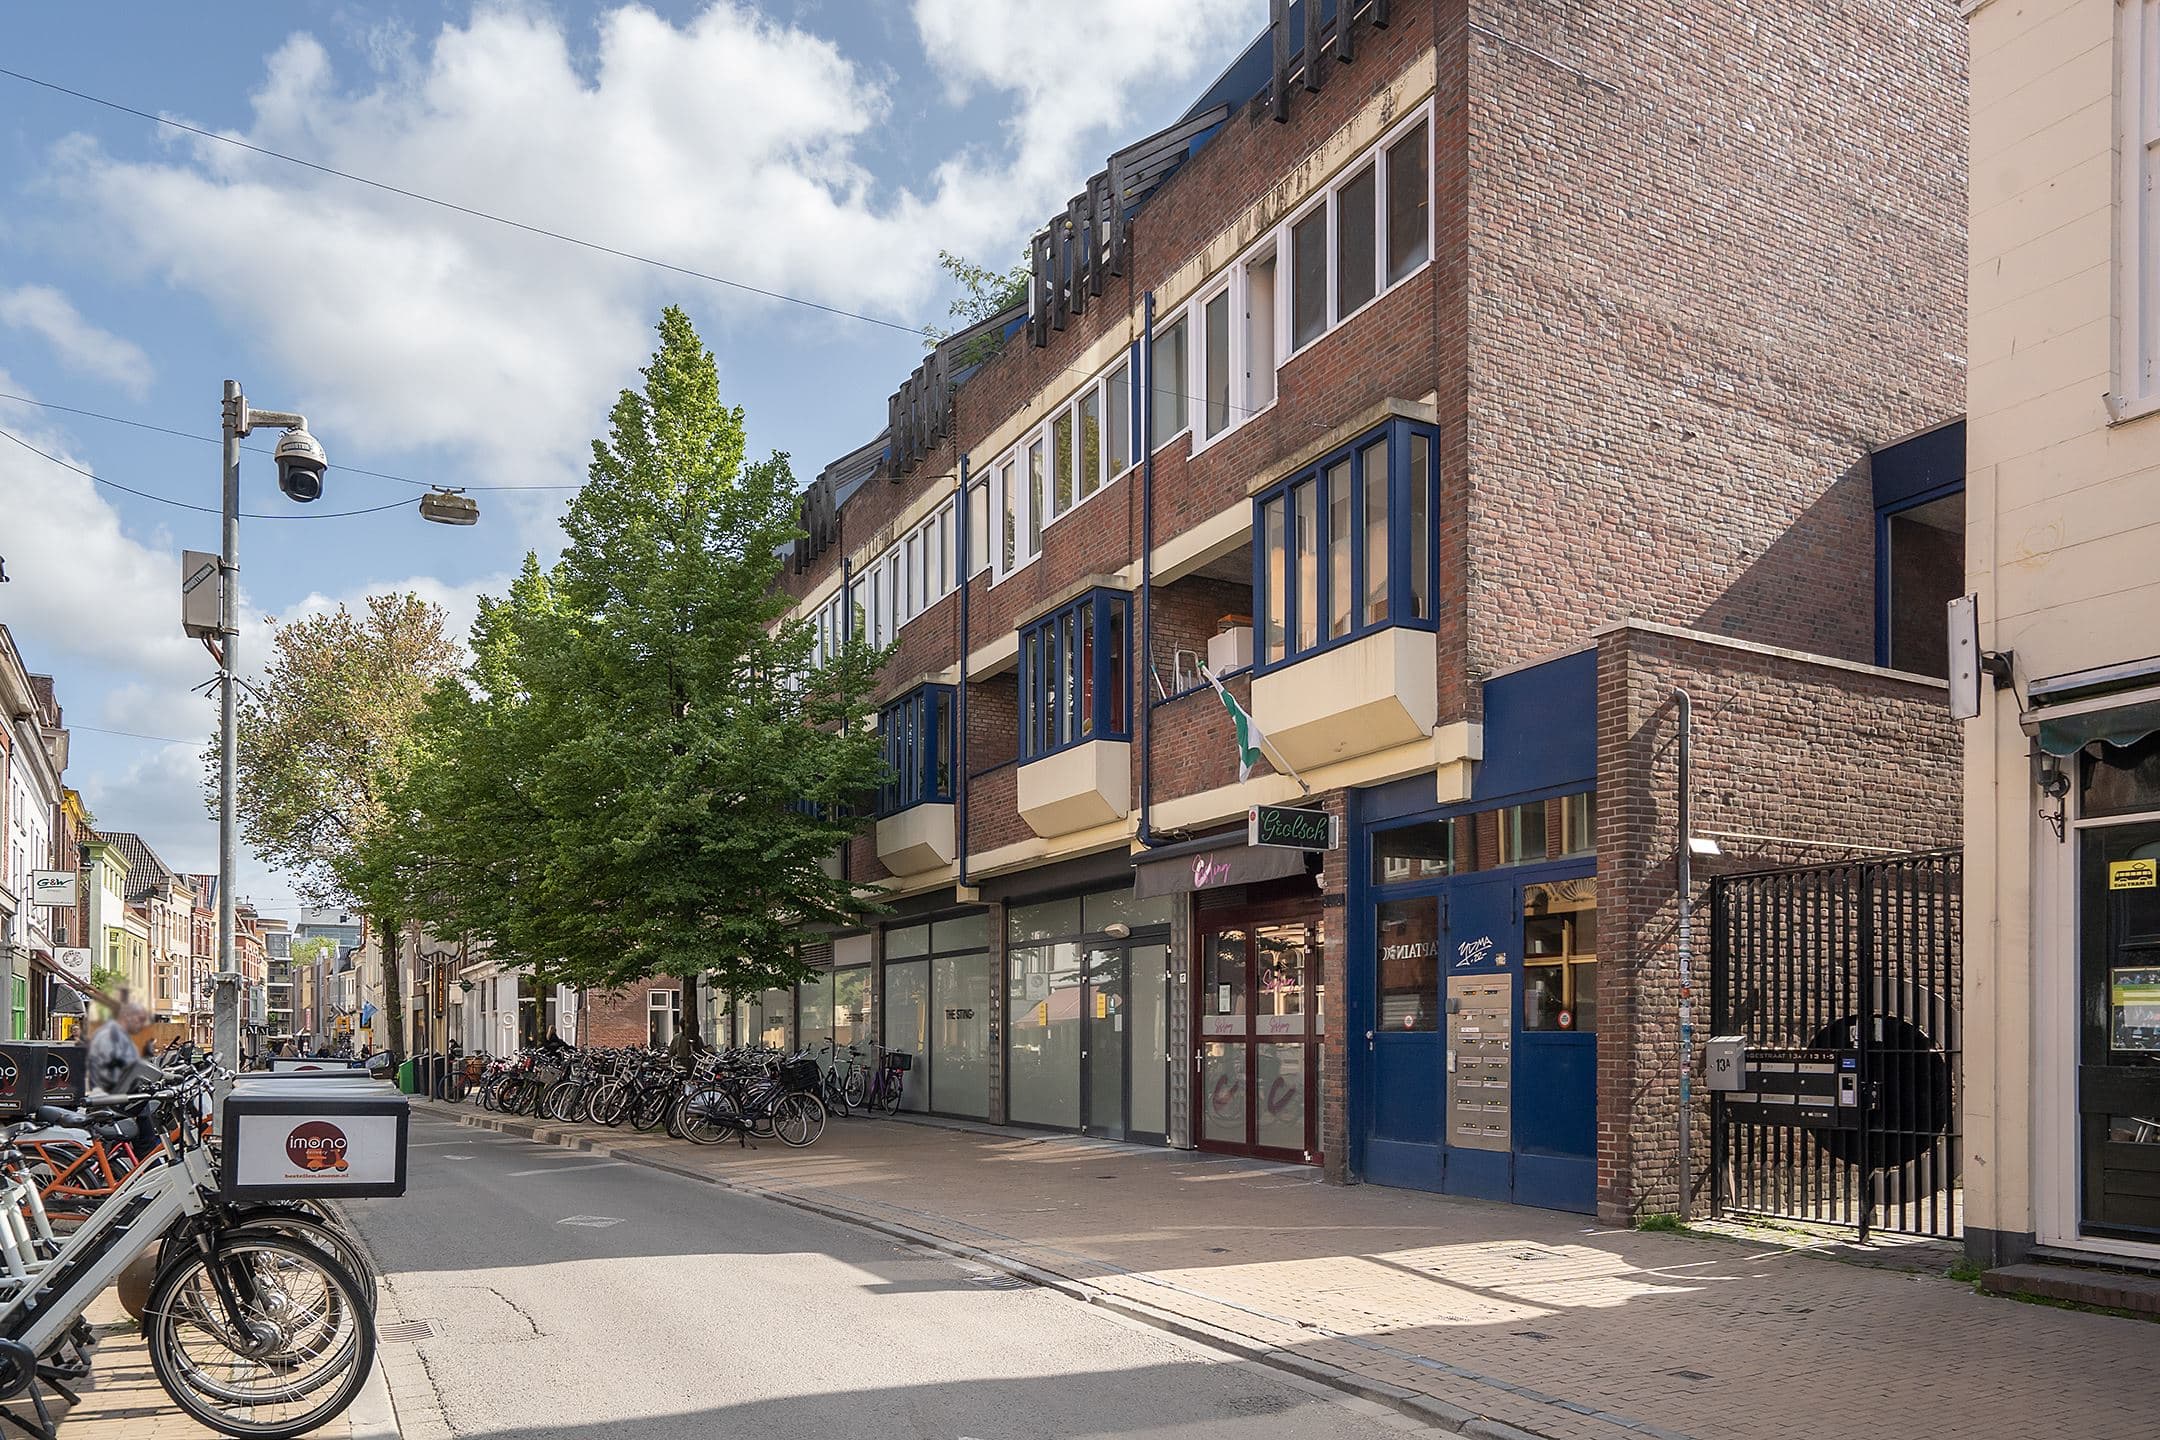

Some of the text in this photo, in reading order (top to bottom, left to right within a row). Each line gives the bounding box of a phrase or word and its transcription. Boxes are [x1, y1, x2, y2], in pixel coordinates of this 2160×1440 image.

[1261, 810, 1328, 842] Grolsch
[37, 878, 74, 888] G&W
[945, 1009, 956, 1020] THE
[1716, 1058, 1731, 1072] 13A
[290, 1135, 347, 1149] imono
